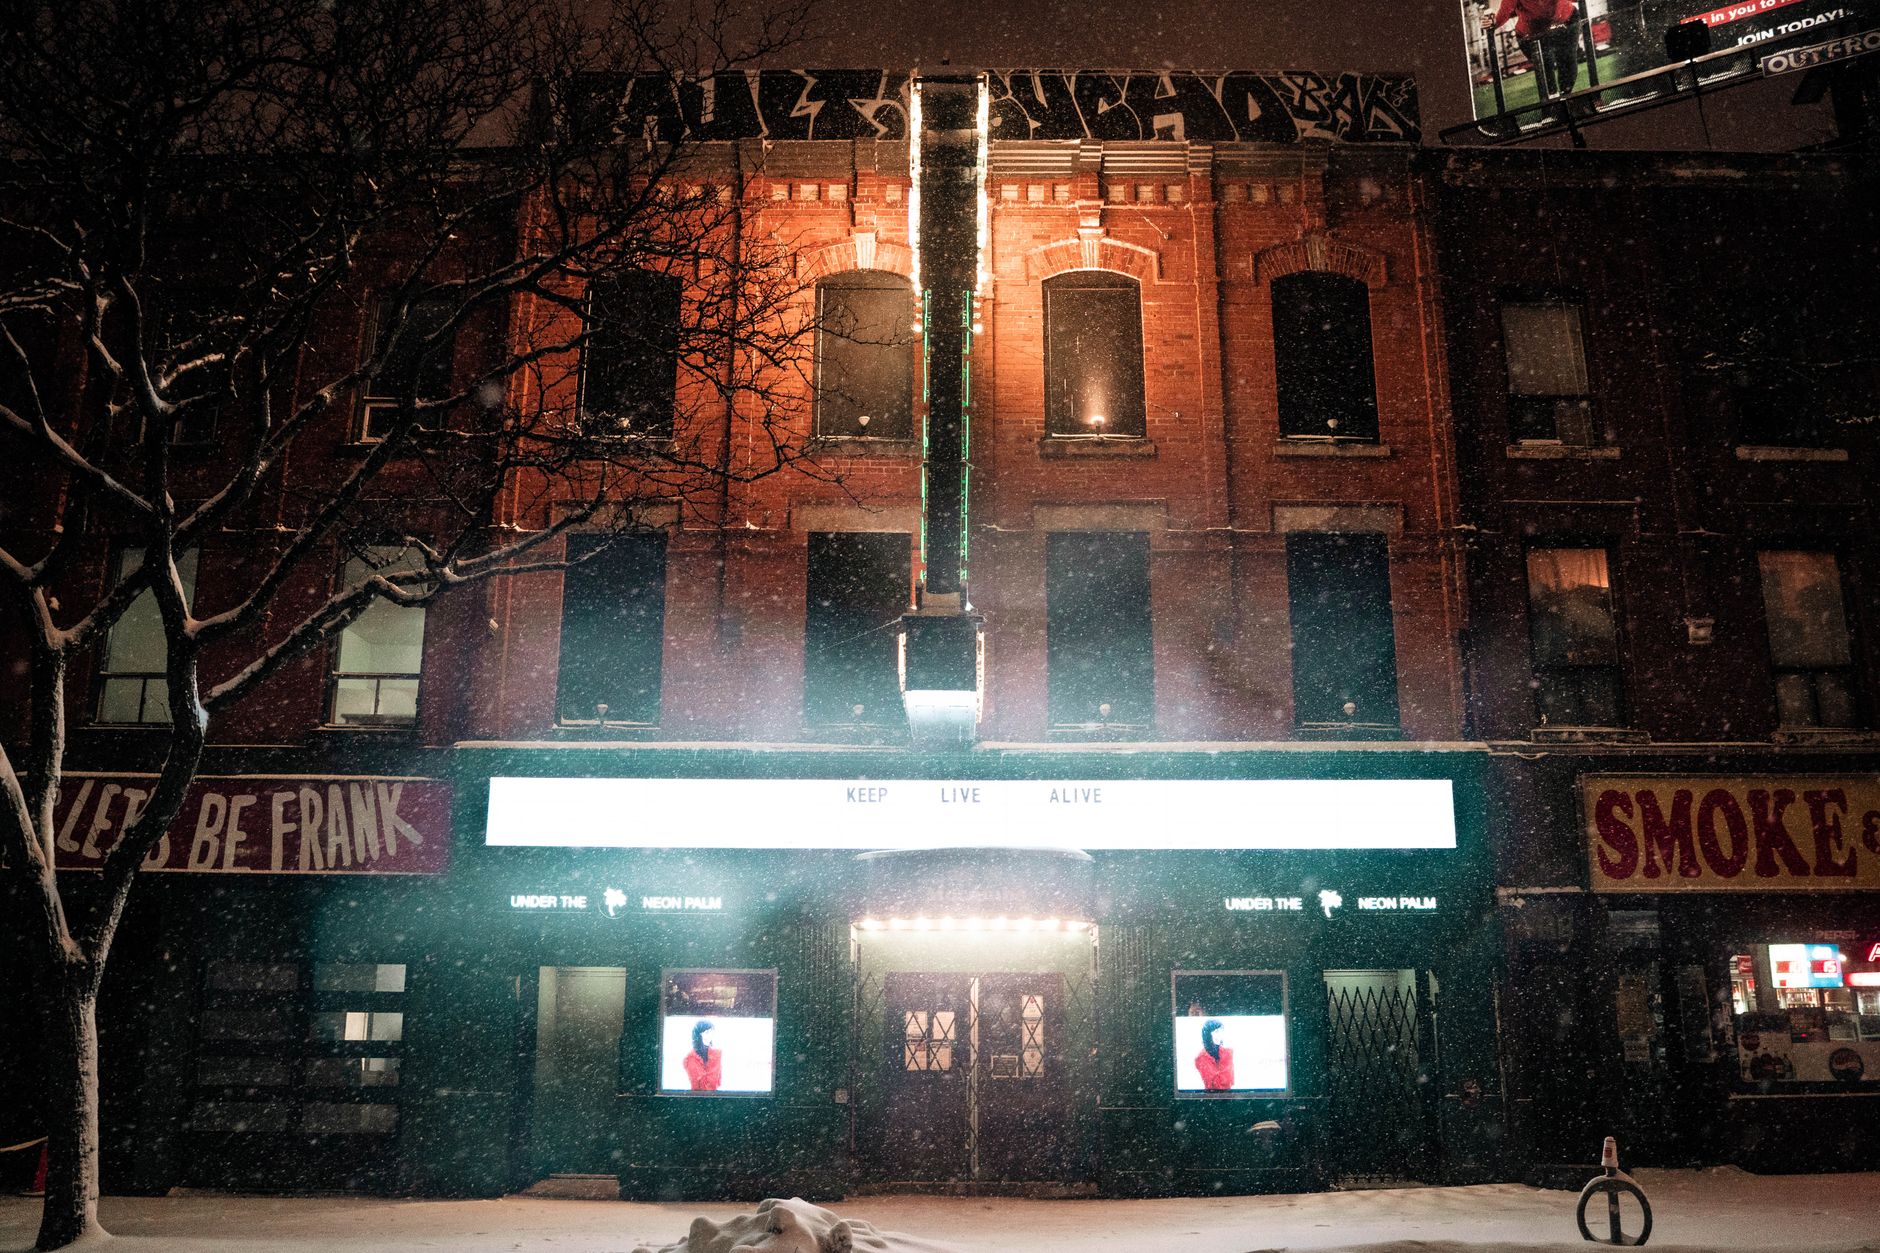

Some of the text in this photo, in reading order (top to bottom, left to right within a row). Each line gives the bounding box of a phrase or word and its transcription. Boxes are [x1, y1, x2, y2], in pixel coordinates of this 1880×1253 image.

[1711, 13, 1725, 23] in
[1728, 4, 1756, 20] you
[1760, 0, 1776, 9] to
[1736, 8, 1845, 47] JOIN TODAY!
[846, 787, 1102, 803] KEEP LIVE ALIVE
[57, 779, 424, 872] LET BE FRANK
[1595, 788, 1857, 880] SMOKE
[510, 895, 722, 910] UNDER THE NEON PALM
[1225, 897, 1437, 911] UNDER THE NEON PALM
